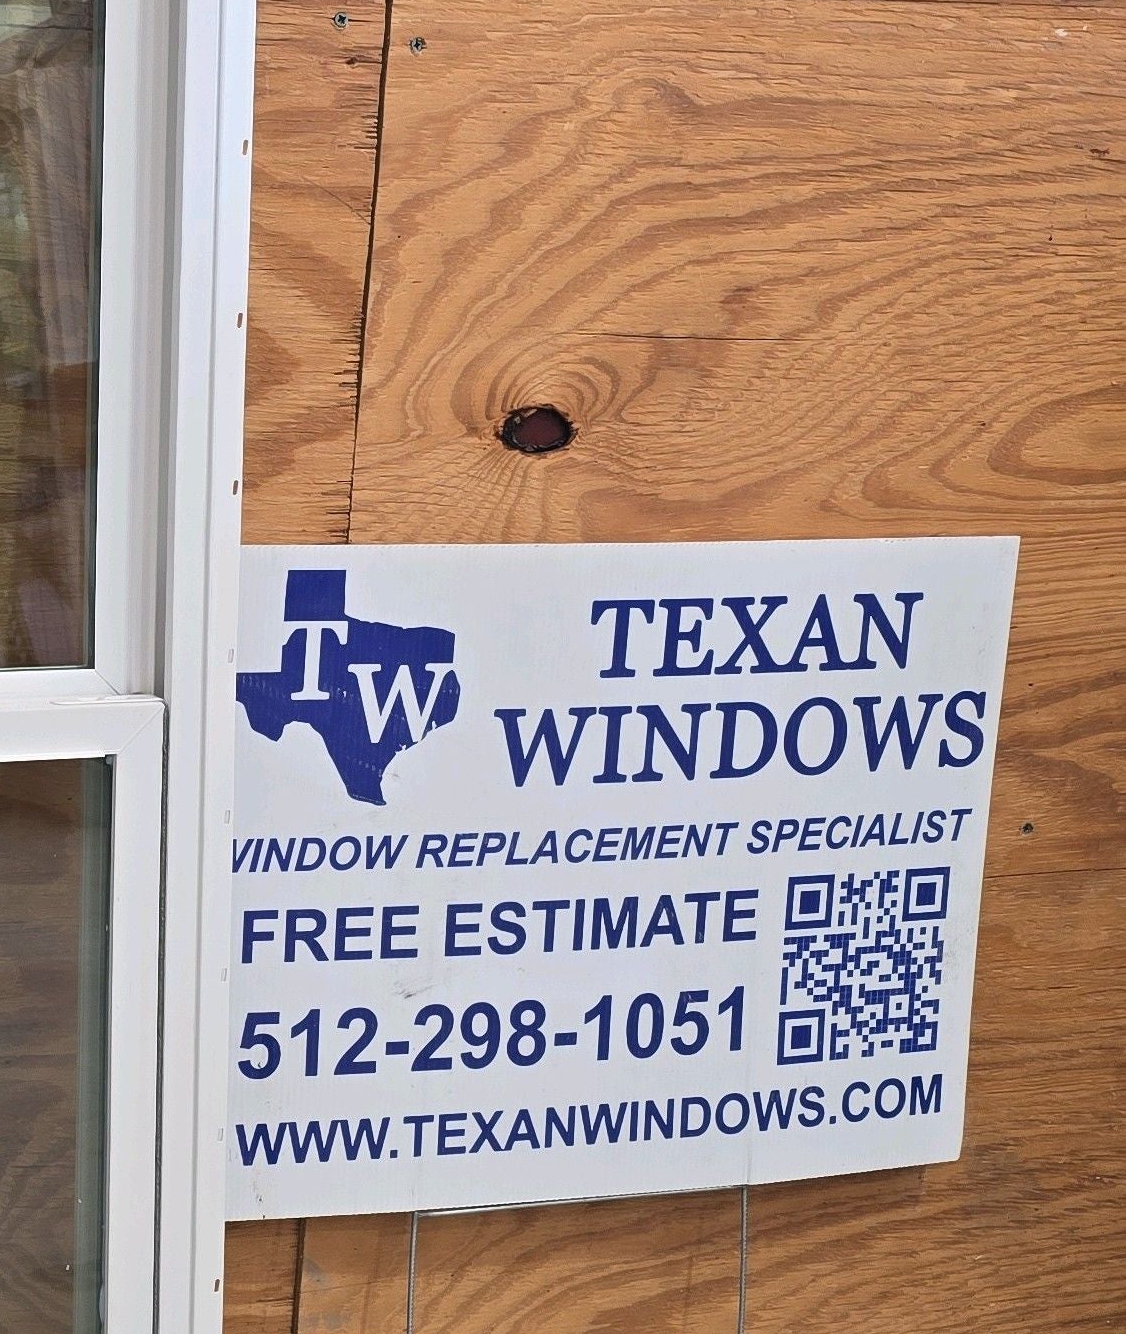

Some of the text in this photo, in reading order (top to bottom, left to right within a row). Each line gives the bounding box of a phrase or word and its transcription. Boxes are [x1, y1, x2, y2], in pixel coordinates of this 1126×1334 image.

[591, 593, 923, 678] TEXAN
[494, 691, 986, 787] WINDOWS
[416, 822, 739, 868] REPLACEMENT
[747, 809, 972, 854] SPECIALIST
[242, 889, 759, 963] FREE ESTIMATE
[238, 986, 744, 1079] 512-298-1051
[236, 1070, 942, 1166] WWW.TEXANWINDOWS.COM
